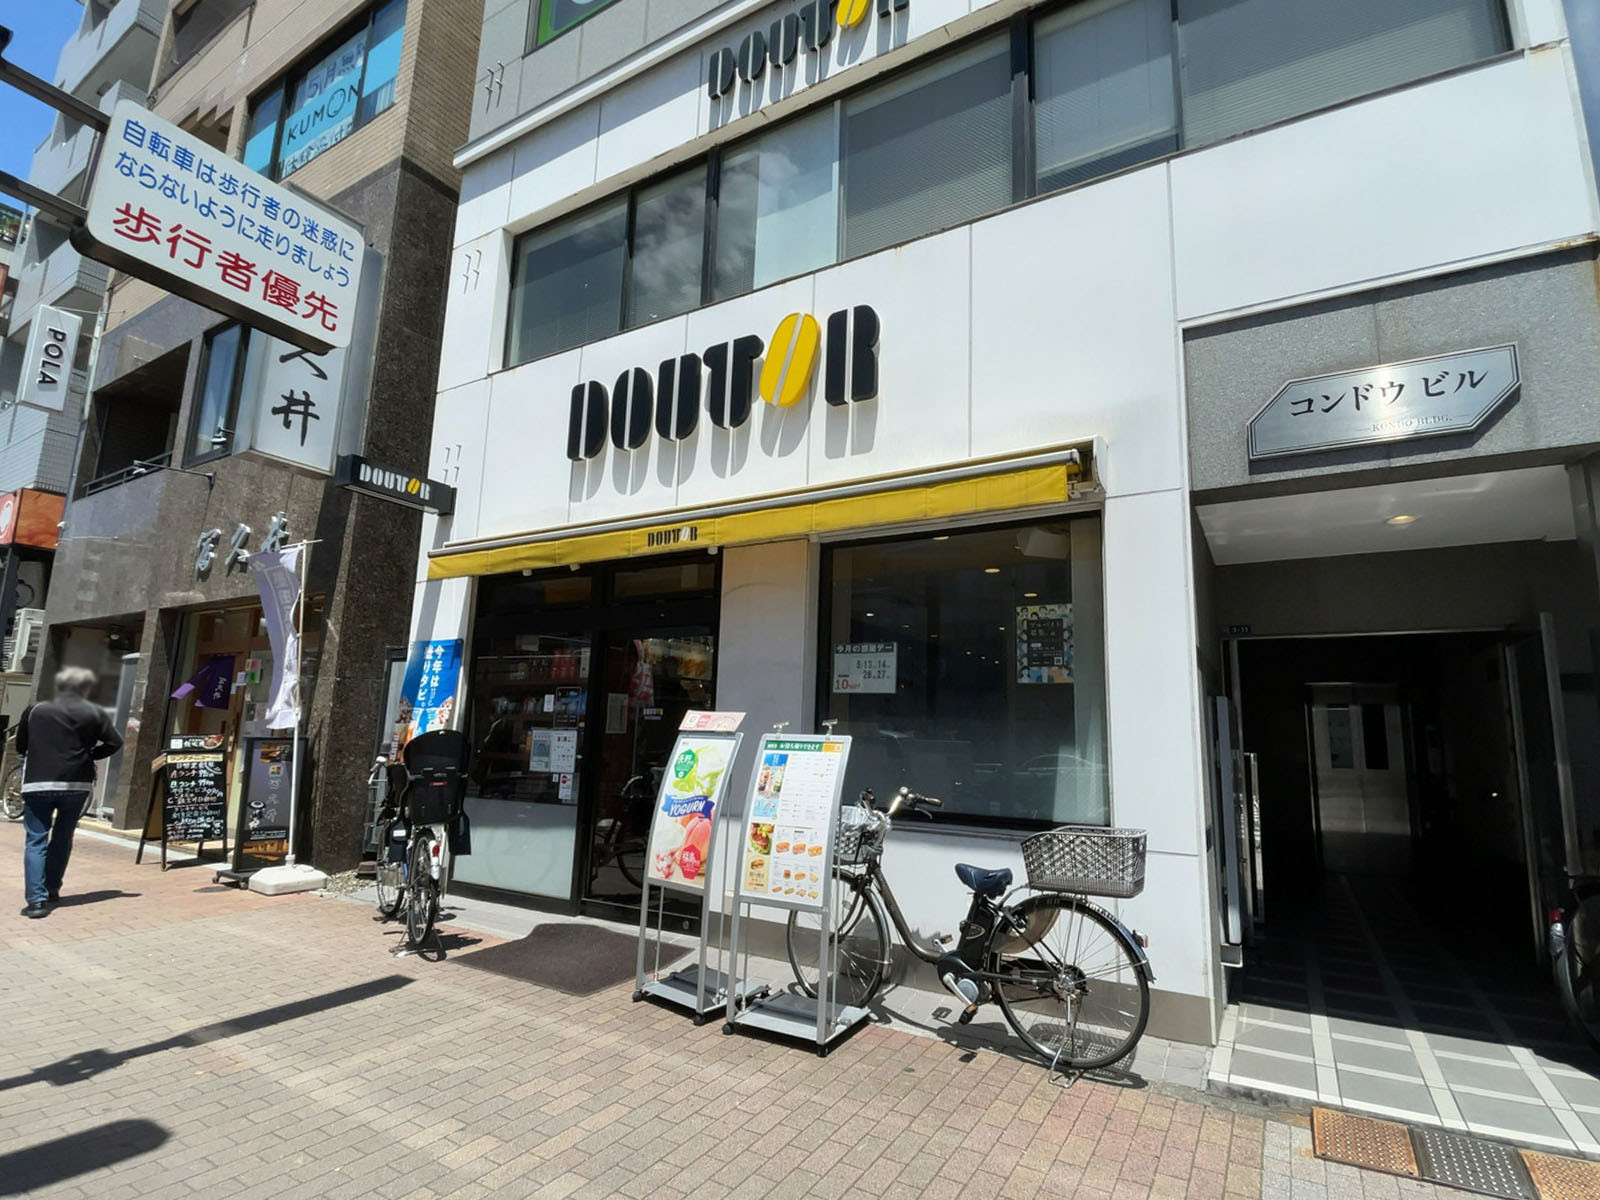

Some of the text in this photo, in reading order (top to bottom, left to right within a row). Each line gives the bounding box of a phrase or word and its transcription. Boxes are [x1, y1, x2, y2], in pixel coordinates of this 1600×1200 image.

[287, 78, 361, 145] KUMON
[114, 151, 350, 288] ならないように走りましょう
[122, 118, 355, 262] 自転車は歩行者の迷惑に
[112, 202, 339, 332] 歩行者優先
[38, 327, 67, 385] POLA
[566, 304, 881, 462] DOUTOR
[1290, 369, 1489, 417] コンドウ ビル
[359, 462, 431, 500] DOUTOR
[647, 525, 698, 547] DOUTOR
[669, 800, 705, 816] YOGURN
